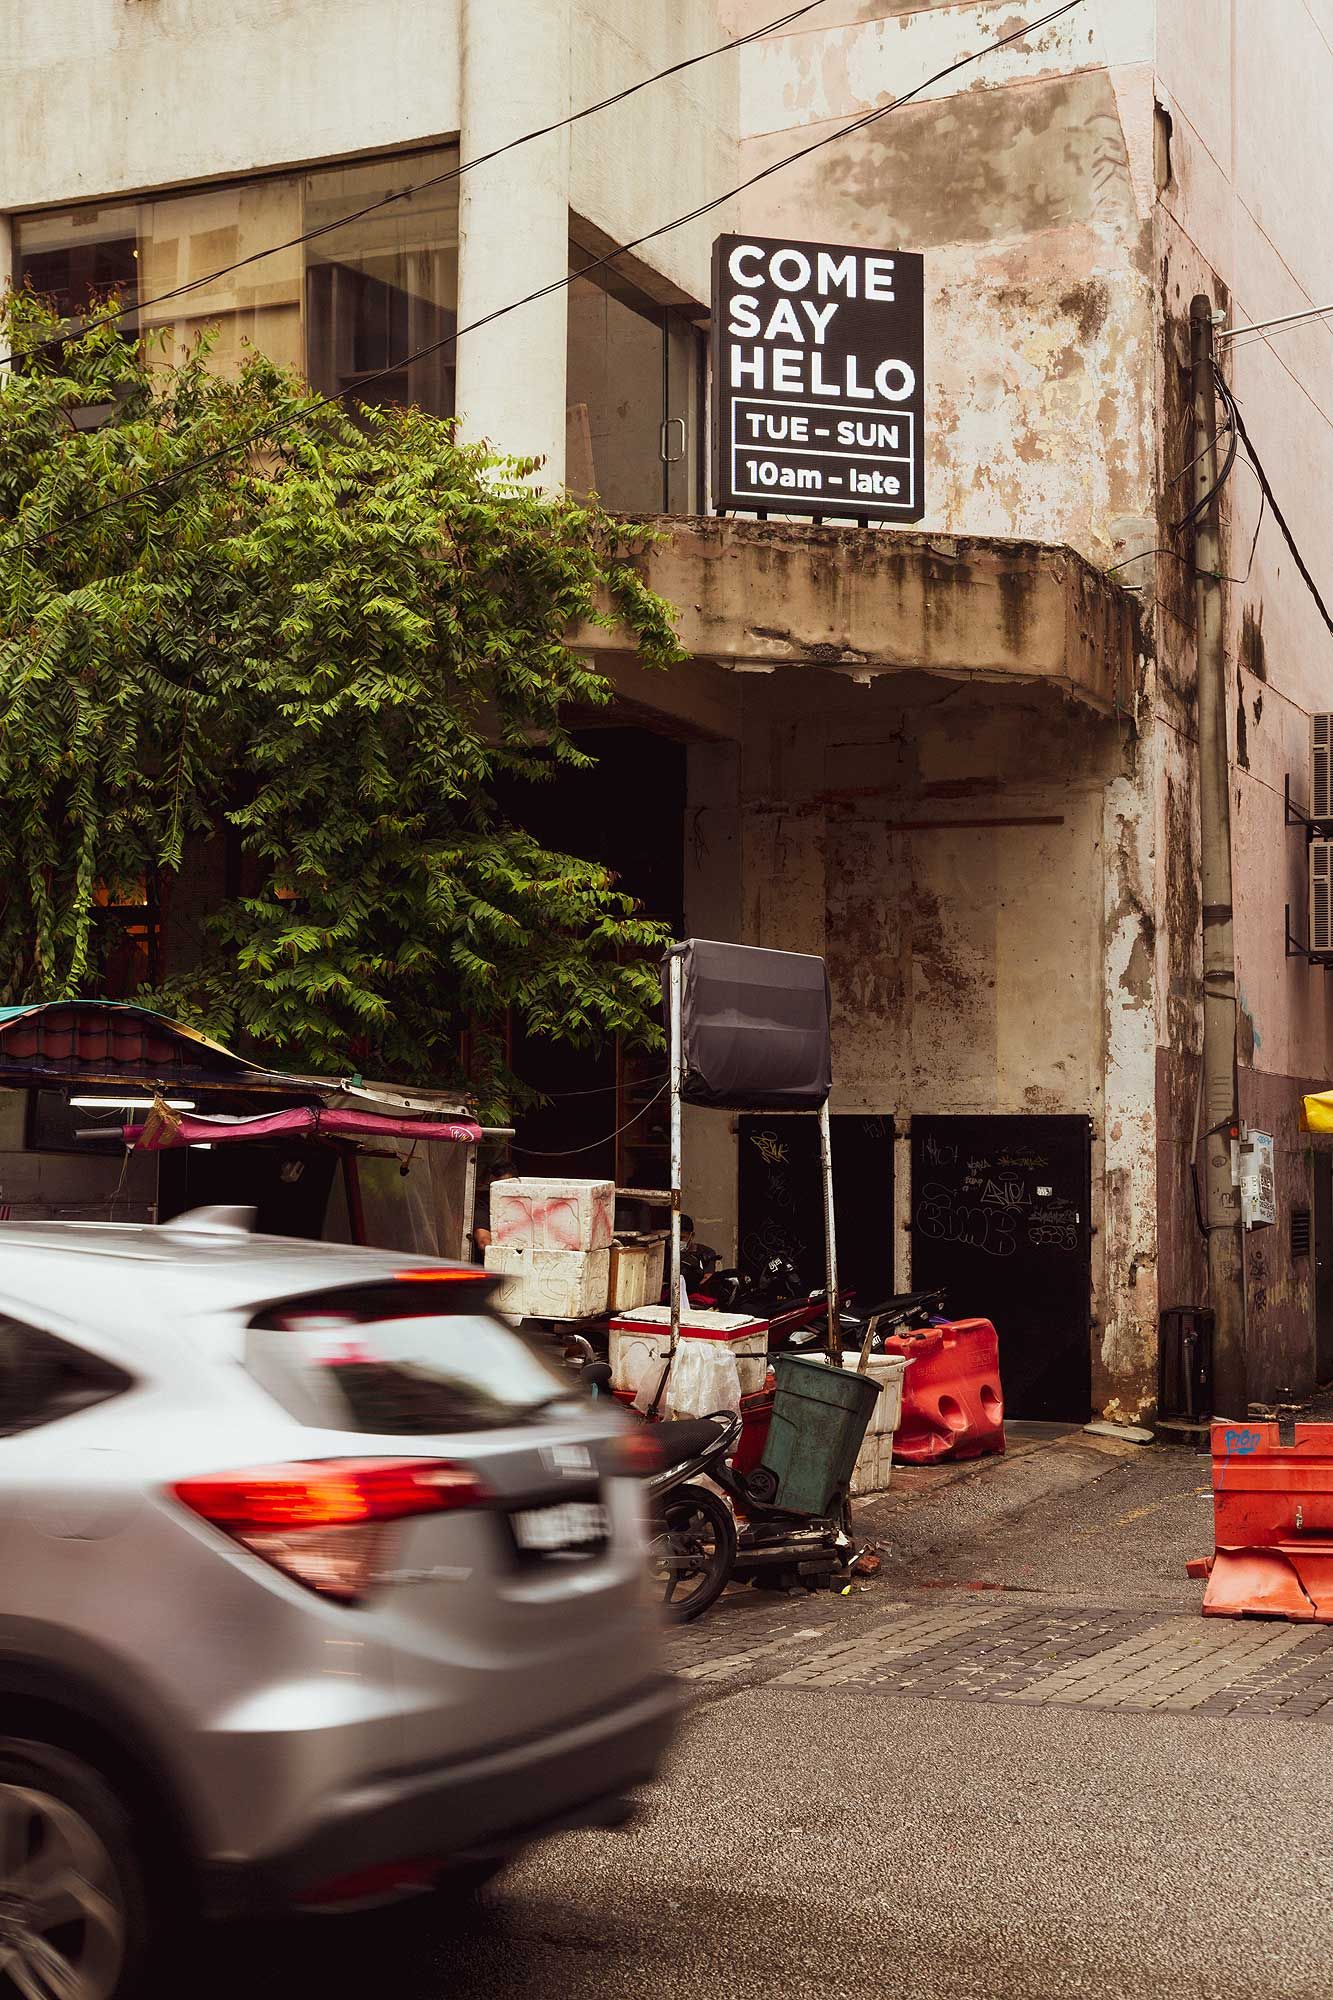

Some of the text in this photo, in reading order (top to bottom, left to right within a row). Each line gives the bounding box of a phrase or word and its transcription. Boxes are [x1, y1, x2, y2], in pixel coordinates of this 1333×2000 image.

[728, 244, 895, 301] COME
[728, 294, 839, 344] SAY
[730, 344, 915, 401] HELLO
[745, 412, 809, 442] TUE
[837, 420, 899, 449] SUN
[745, 460, 822, 490] 10am
[849, 468, 900, 495] late
